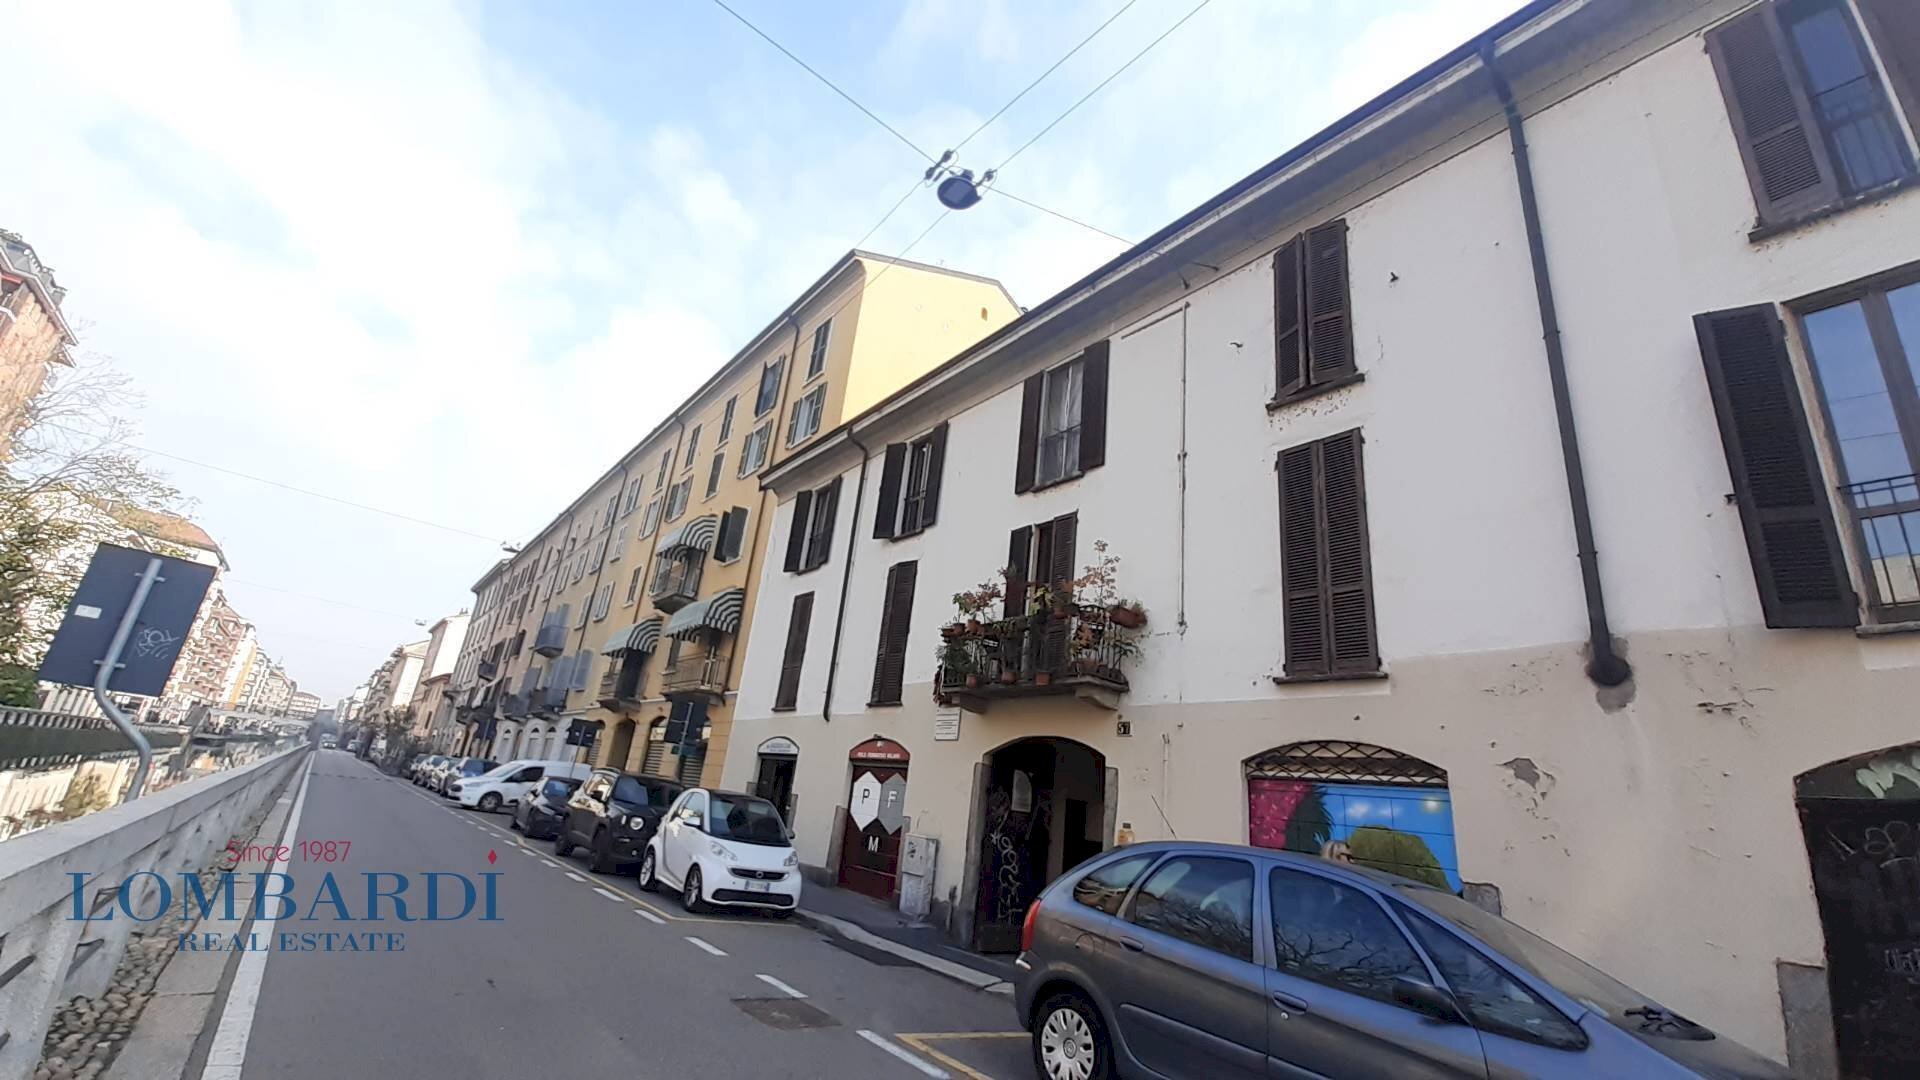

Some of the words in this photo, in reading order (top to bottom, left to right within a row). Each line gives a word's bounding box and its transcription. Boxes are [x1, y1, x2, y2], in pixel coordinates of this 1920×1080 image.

[1118, 722, 1130, 735] 57
[861, 787, 871, 805] P
[887, 790, 898, 809] F
[867, 835, 880, 853] M
